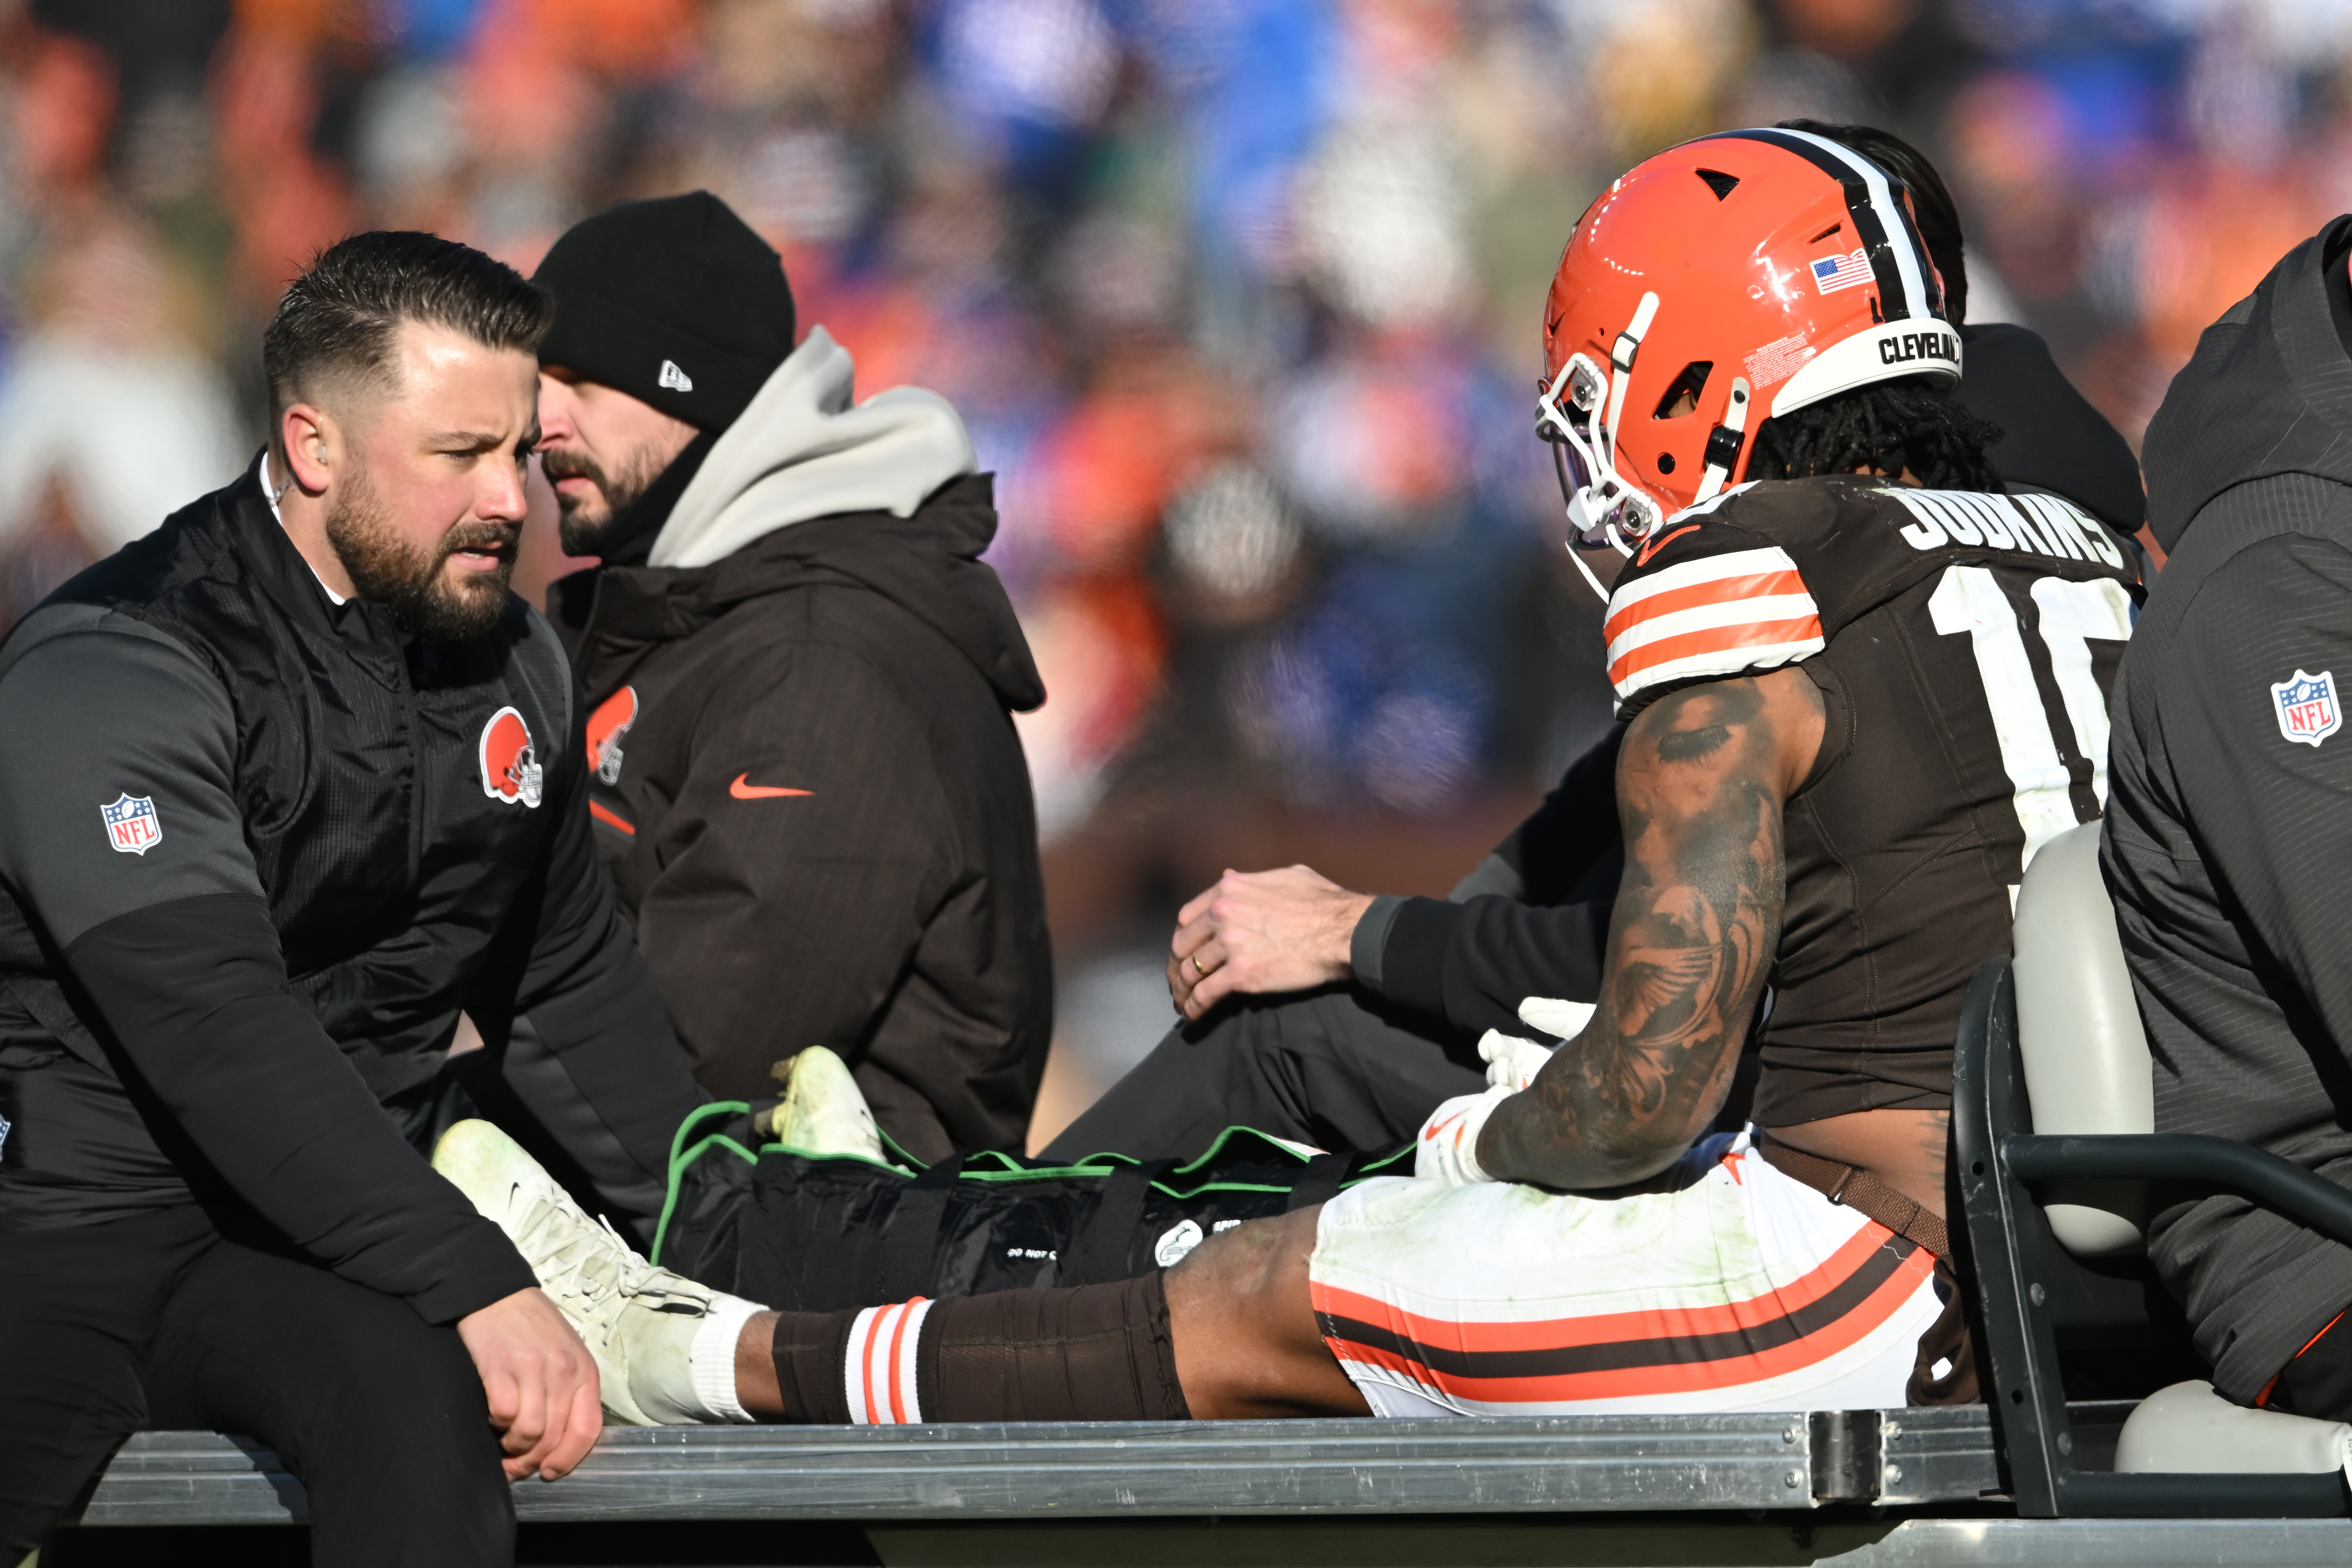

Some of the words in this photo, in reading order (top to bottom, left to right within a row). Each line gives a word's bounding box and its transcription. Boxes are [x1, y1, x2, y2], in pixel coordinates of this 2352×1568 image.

[1756, 337, 1788, 352] WARNING
[1878, 332, 1959, 366] CLEVELAND
[1866, 486, 2124, 570] JUDKINS
[2288, 701, 2331, 731] NFL
[113, 818, 155, 845] NFL
[1007, 1248, 1023, 1257] DO
[1024, 1249, 1047, 1258] NOT
